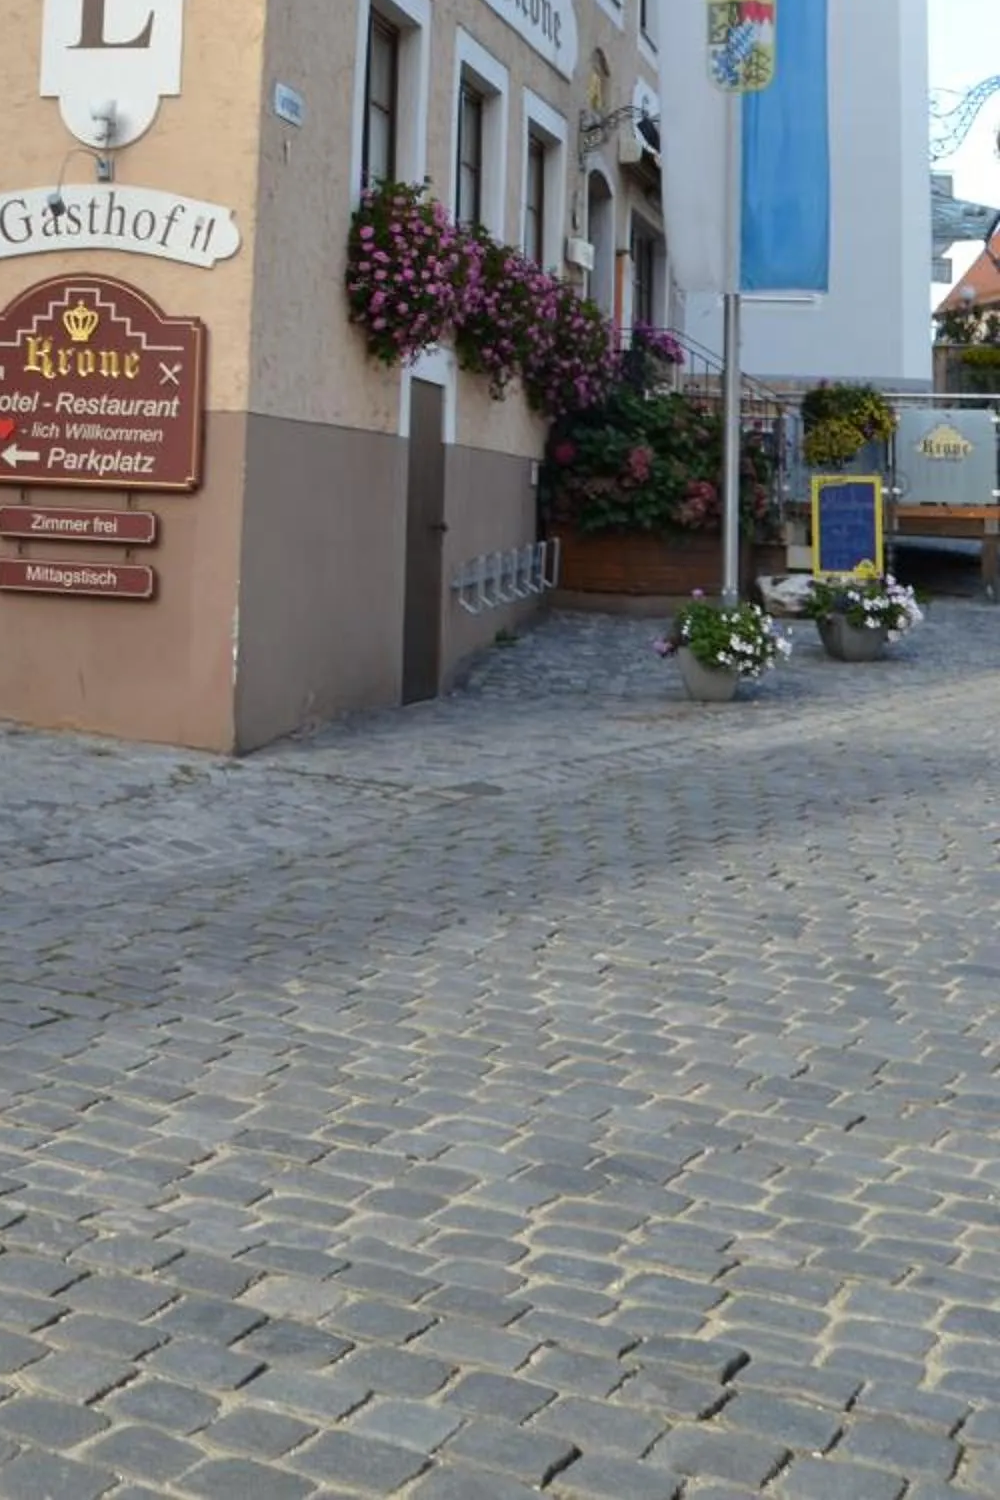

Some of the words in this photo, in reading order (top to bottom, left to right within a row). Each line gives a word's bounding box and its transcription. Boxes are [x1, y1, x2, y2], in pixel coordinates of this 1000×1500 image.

[23, 336, 141, 379] Krone
[55, 391, 180, 417] Restaurant
[65, 423, 164, 443] Willkommen
[47, 447, 156, 476] Parkplatz
[31, 513, 90, 533] Zimmer
[93, 516, 118, 533] frei
[25, 565, 117, 588] Mittagstisch
